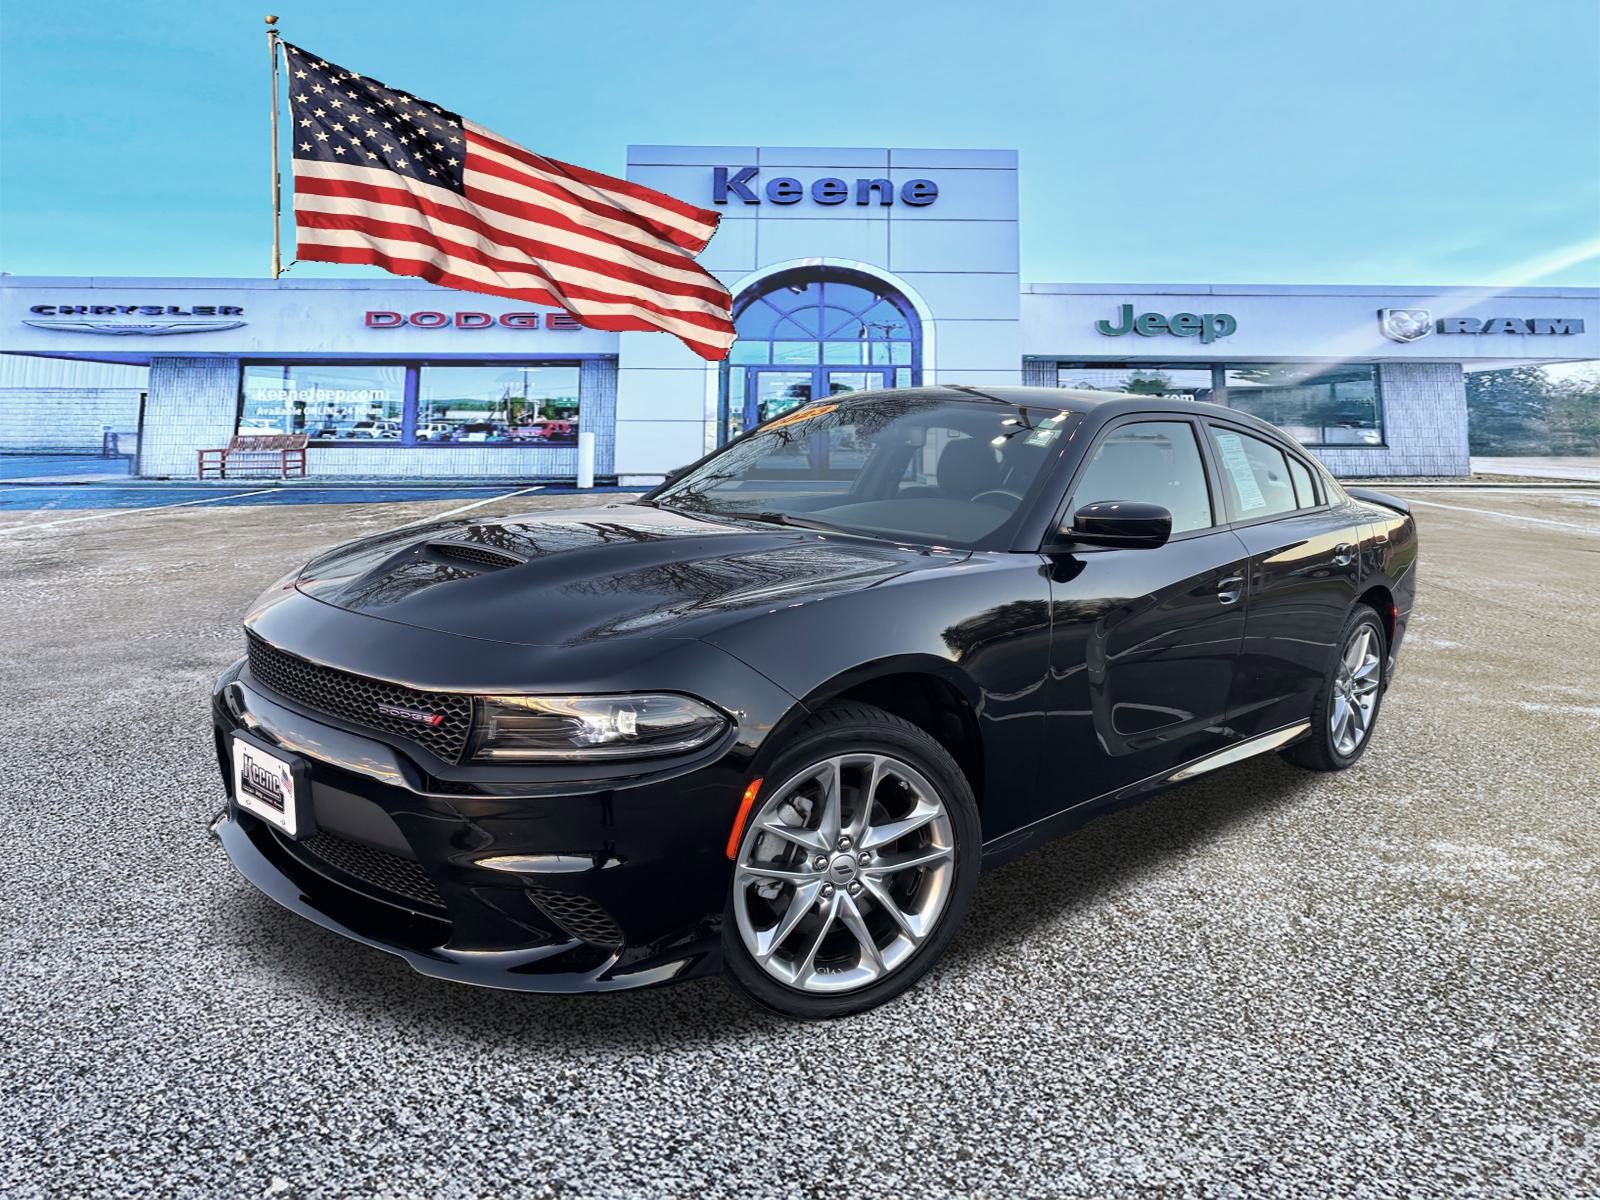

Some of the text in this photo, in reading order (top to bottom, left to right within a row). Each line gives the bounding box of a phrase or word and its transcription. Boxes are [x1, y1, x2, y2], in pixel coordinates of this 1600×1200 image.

[713, 167, 939, 206] Keene
[30, 304, 245, 317] CHRYSLER
[365, 311, 583, 330] DODGE
[1096, 303, 1237, 344] Jeep
[1436, 317, 1586, 335] RAM
[256, 388, 385, 404] KeeneJeep.com
[256, 406, 301, 416] Available
[378, 706, 434, 724] DODGE
[242, 752, 281, 795] Keene
